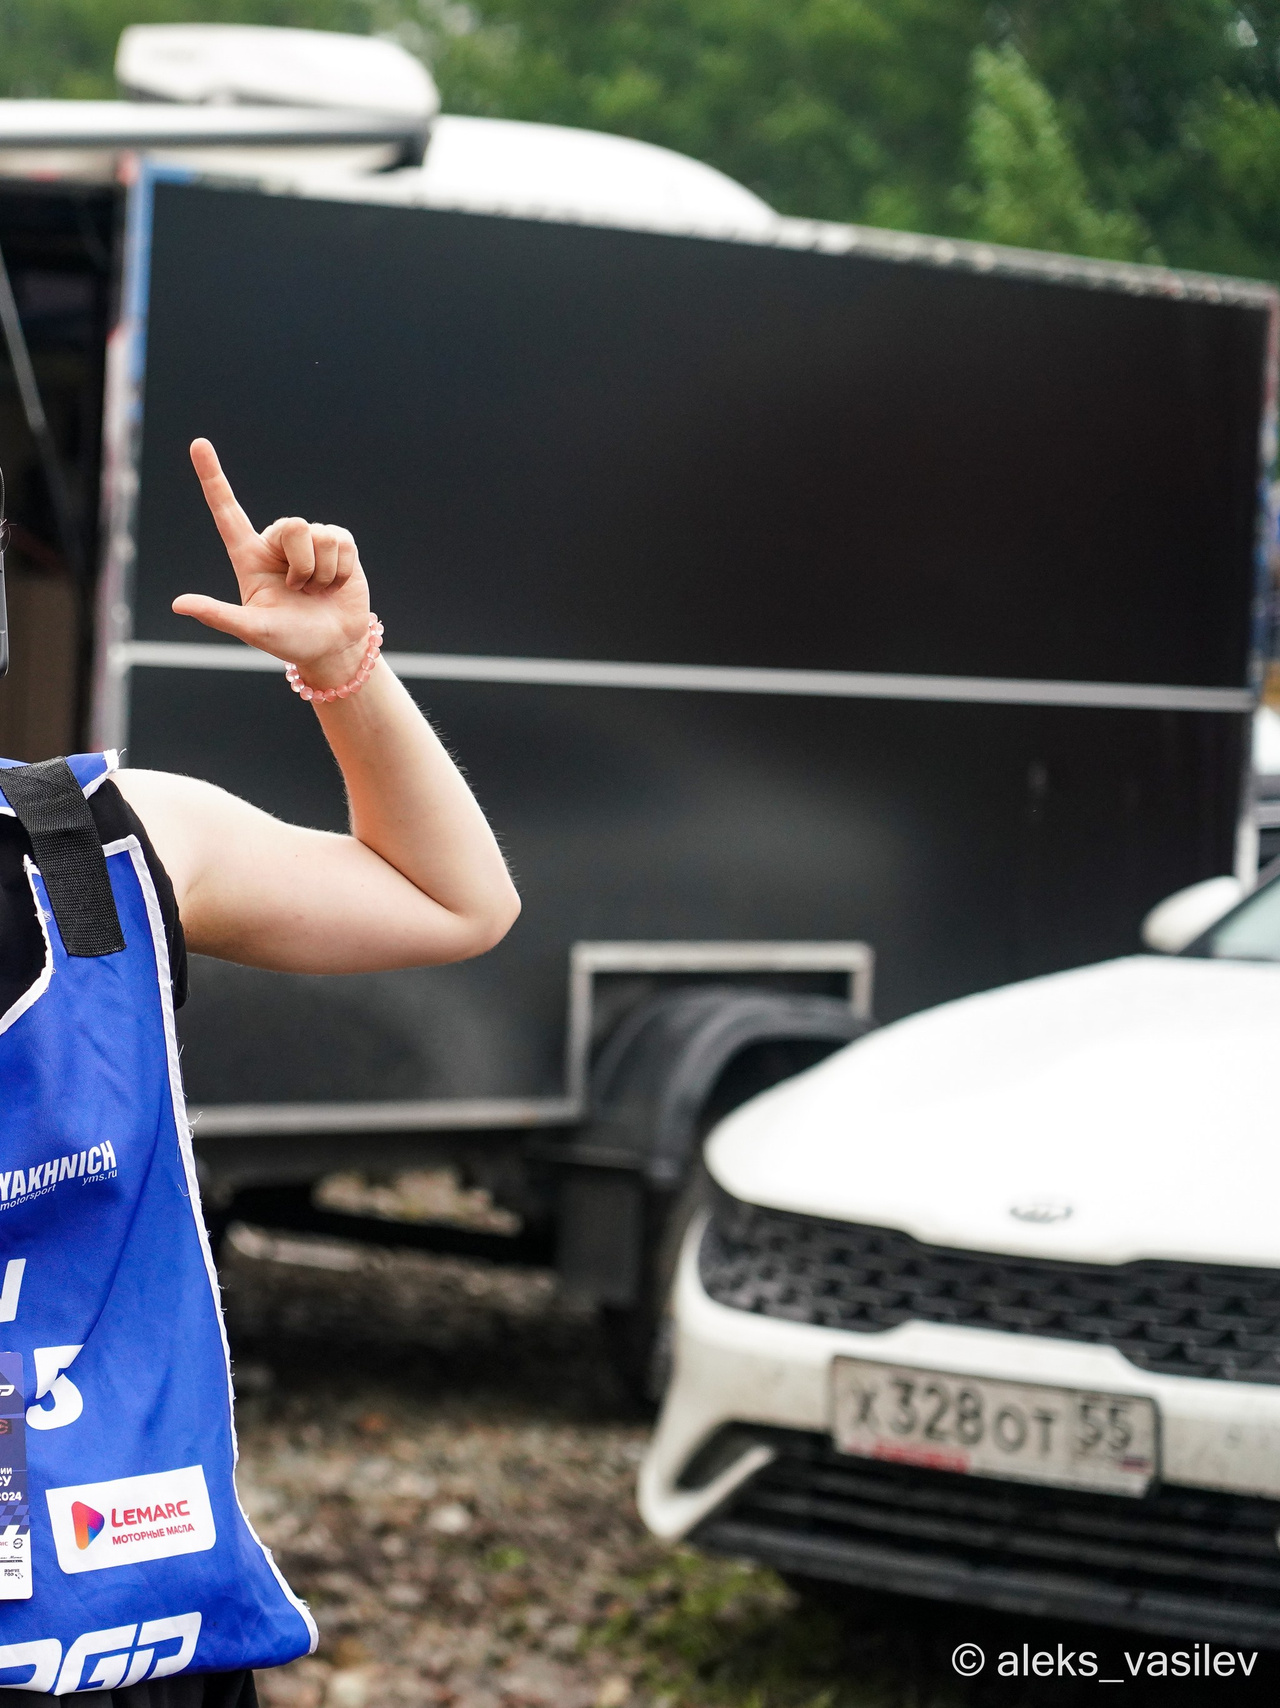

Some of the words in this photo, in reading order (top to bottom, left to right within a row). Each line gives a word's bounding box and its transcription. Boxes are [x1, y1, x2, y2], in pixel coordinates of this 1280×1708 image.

[0, 1183, 57, 1211] motorsport
[82, 1169, 117, 1186] yms.ru
[26, 1344, 84, 1430] 5
[111, 1500, 190, 1528] LEMARC
[112, 1528, 165, 1545] МОТОРНЫЕ
[166, 1523, 195, 1536] МАСЛА
